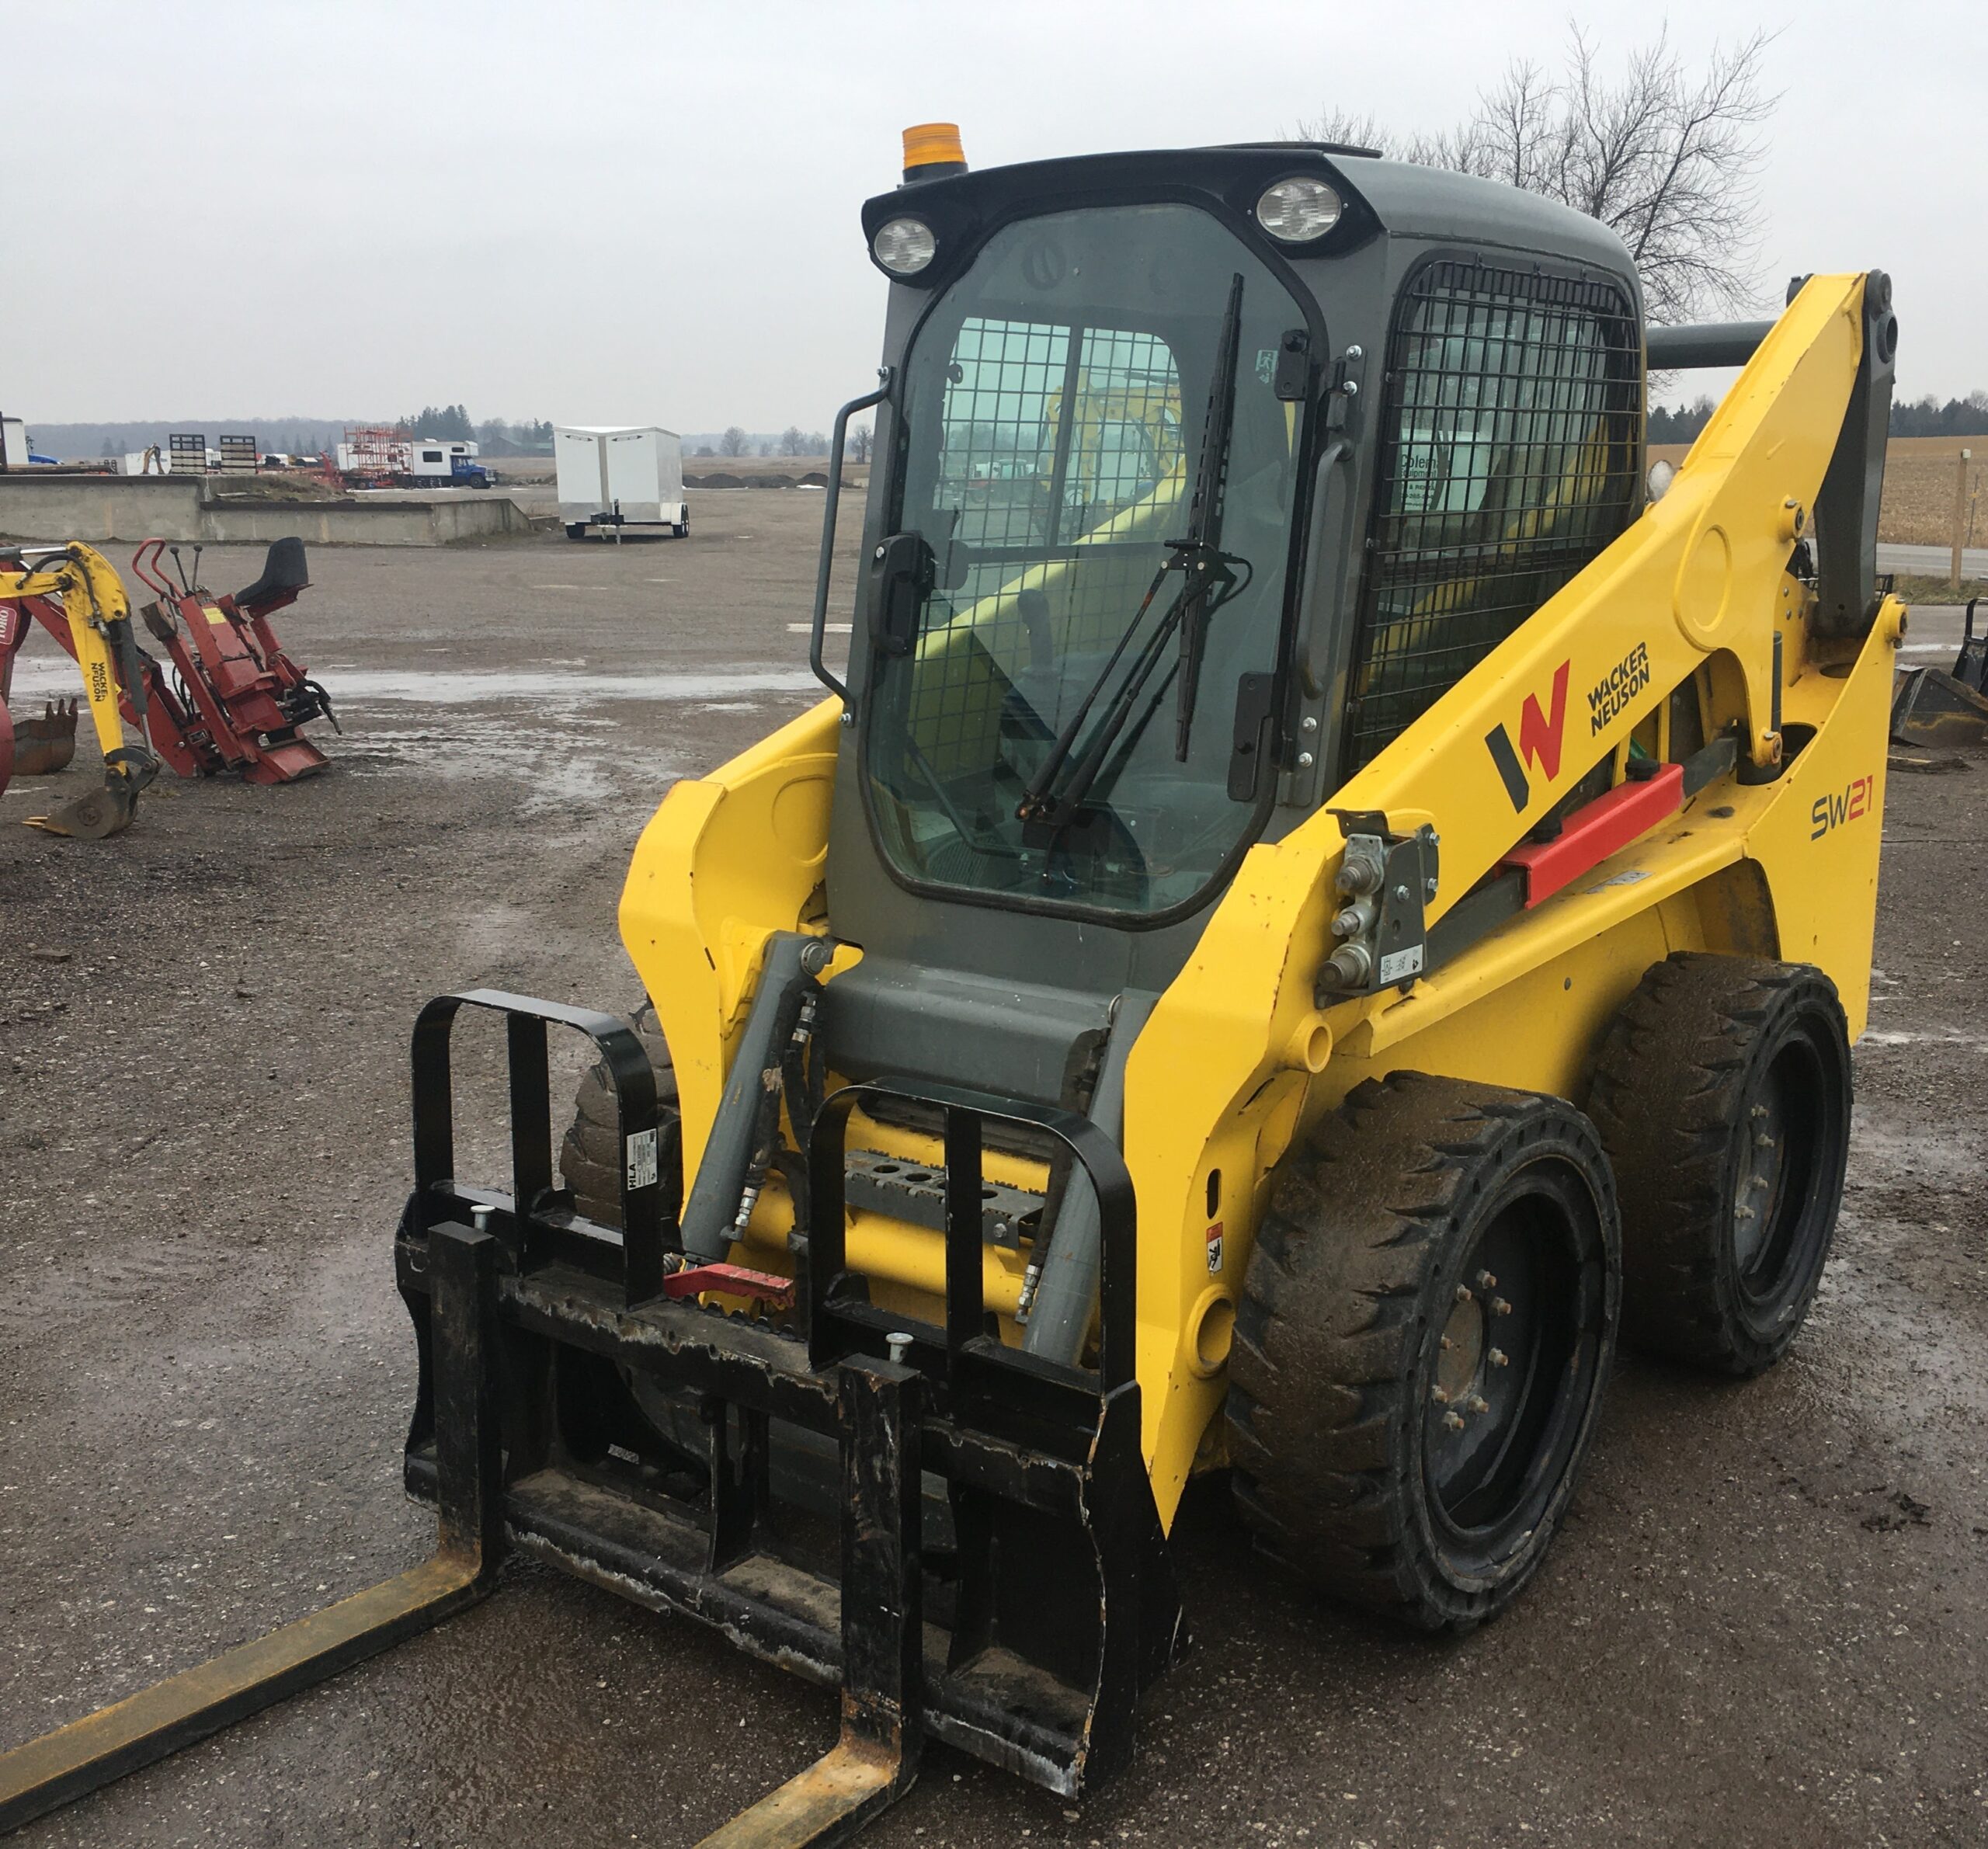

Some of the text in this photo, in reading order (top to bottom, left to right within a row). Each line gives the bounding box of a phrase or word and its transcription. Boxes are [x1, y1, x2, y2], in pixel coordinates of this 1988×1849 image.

[1587, 641, 1648, 711] WACKER
[1590, 662, 1649, 738] NEUSON
[1811, 774, 1873, 841] SW21
